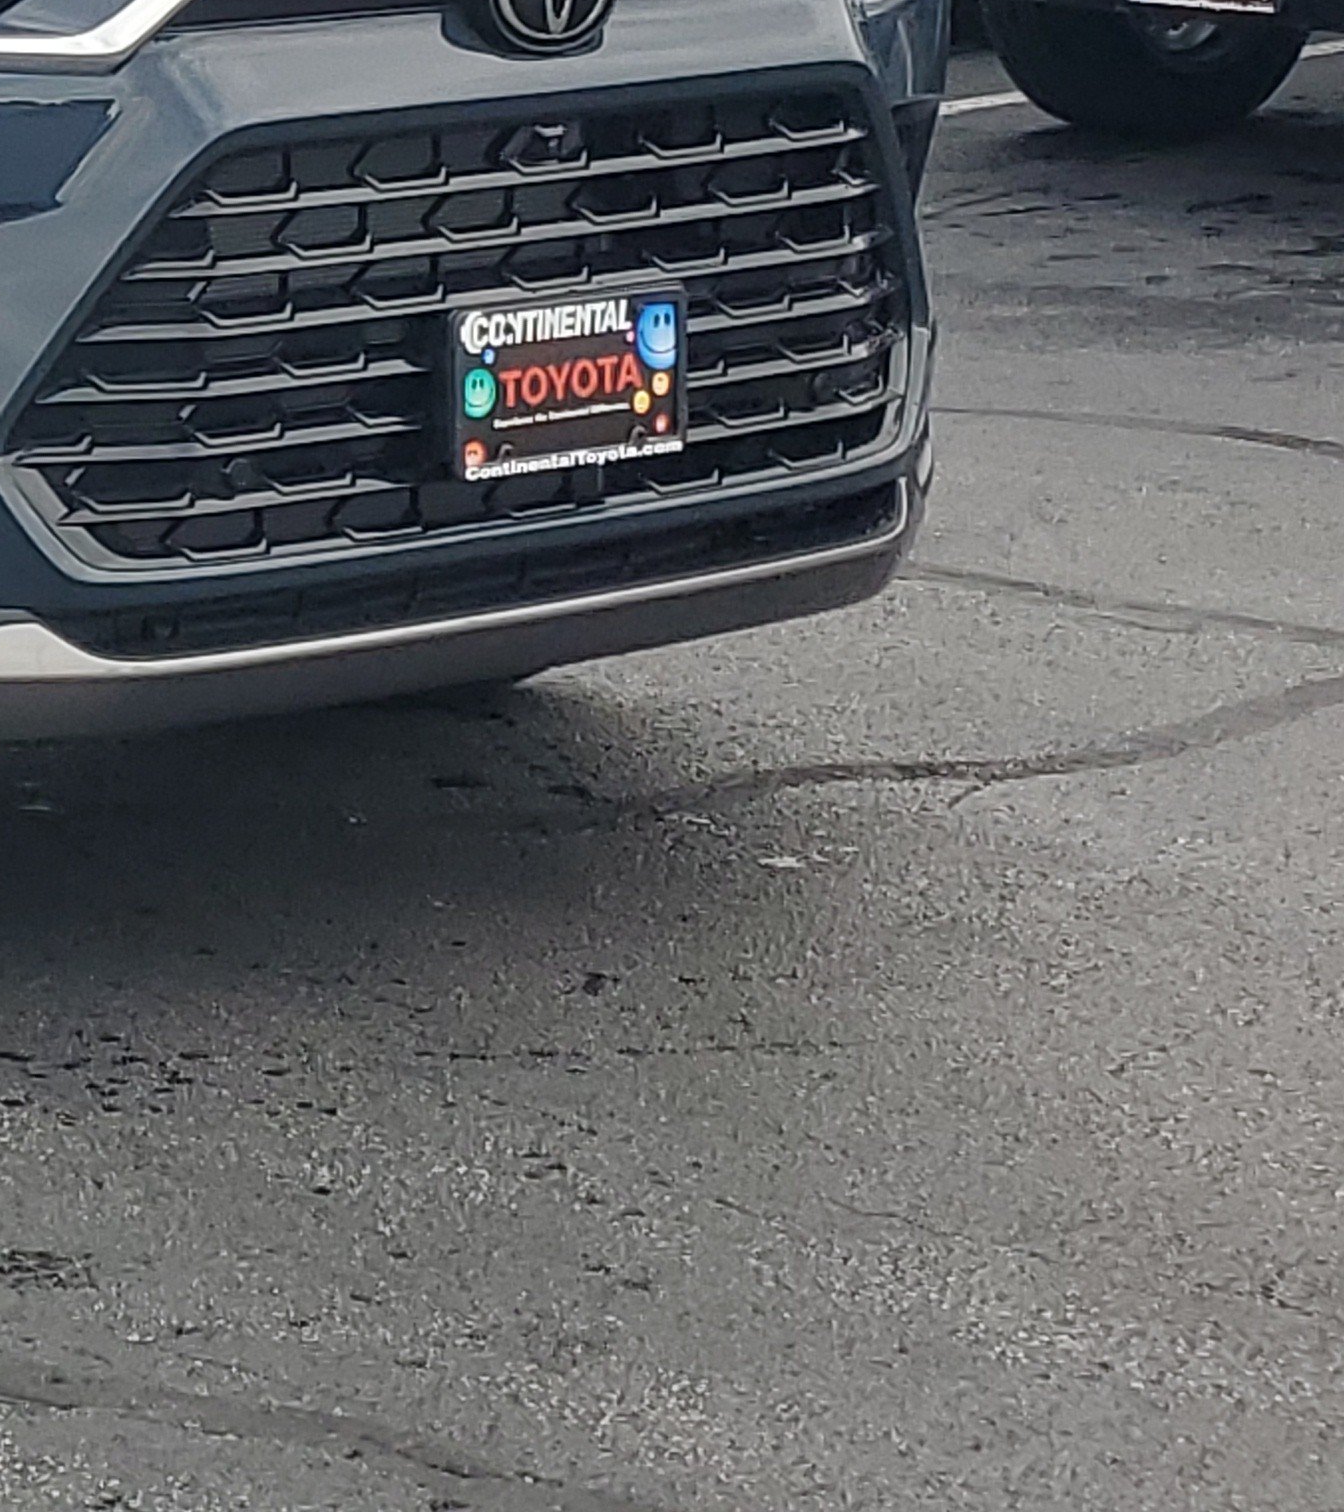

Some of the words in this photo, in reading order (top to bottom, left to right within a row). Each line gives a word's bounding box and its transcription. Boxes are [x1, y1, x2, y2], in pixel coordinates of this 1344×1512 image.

[459, 299, 633, 354] CONTINENTAL
[498, 351, 643, 408] TOYOTA
[465, 439, 683, 482] ContinentalToyota.com
